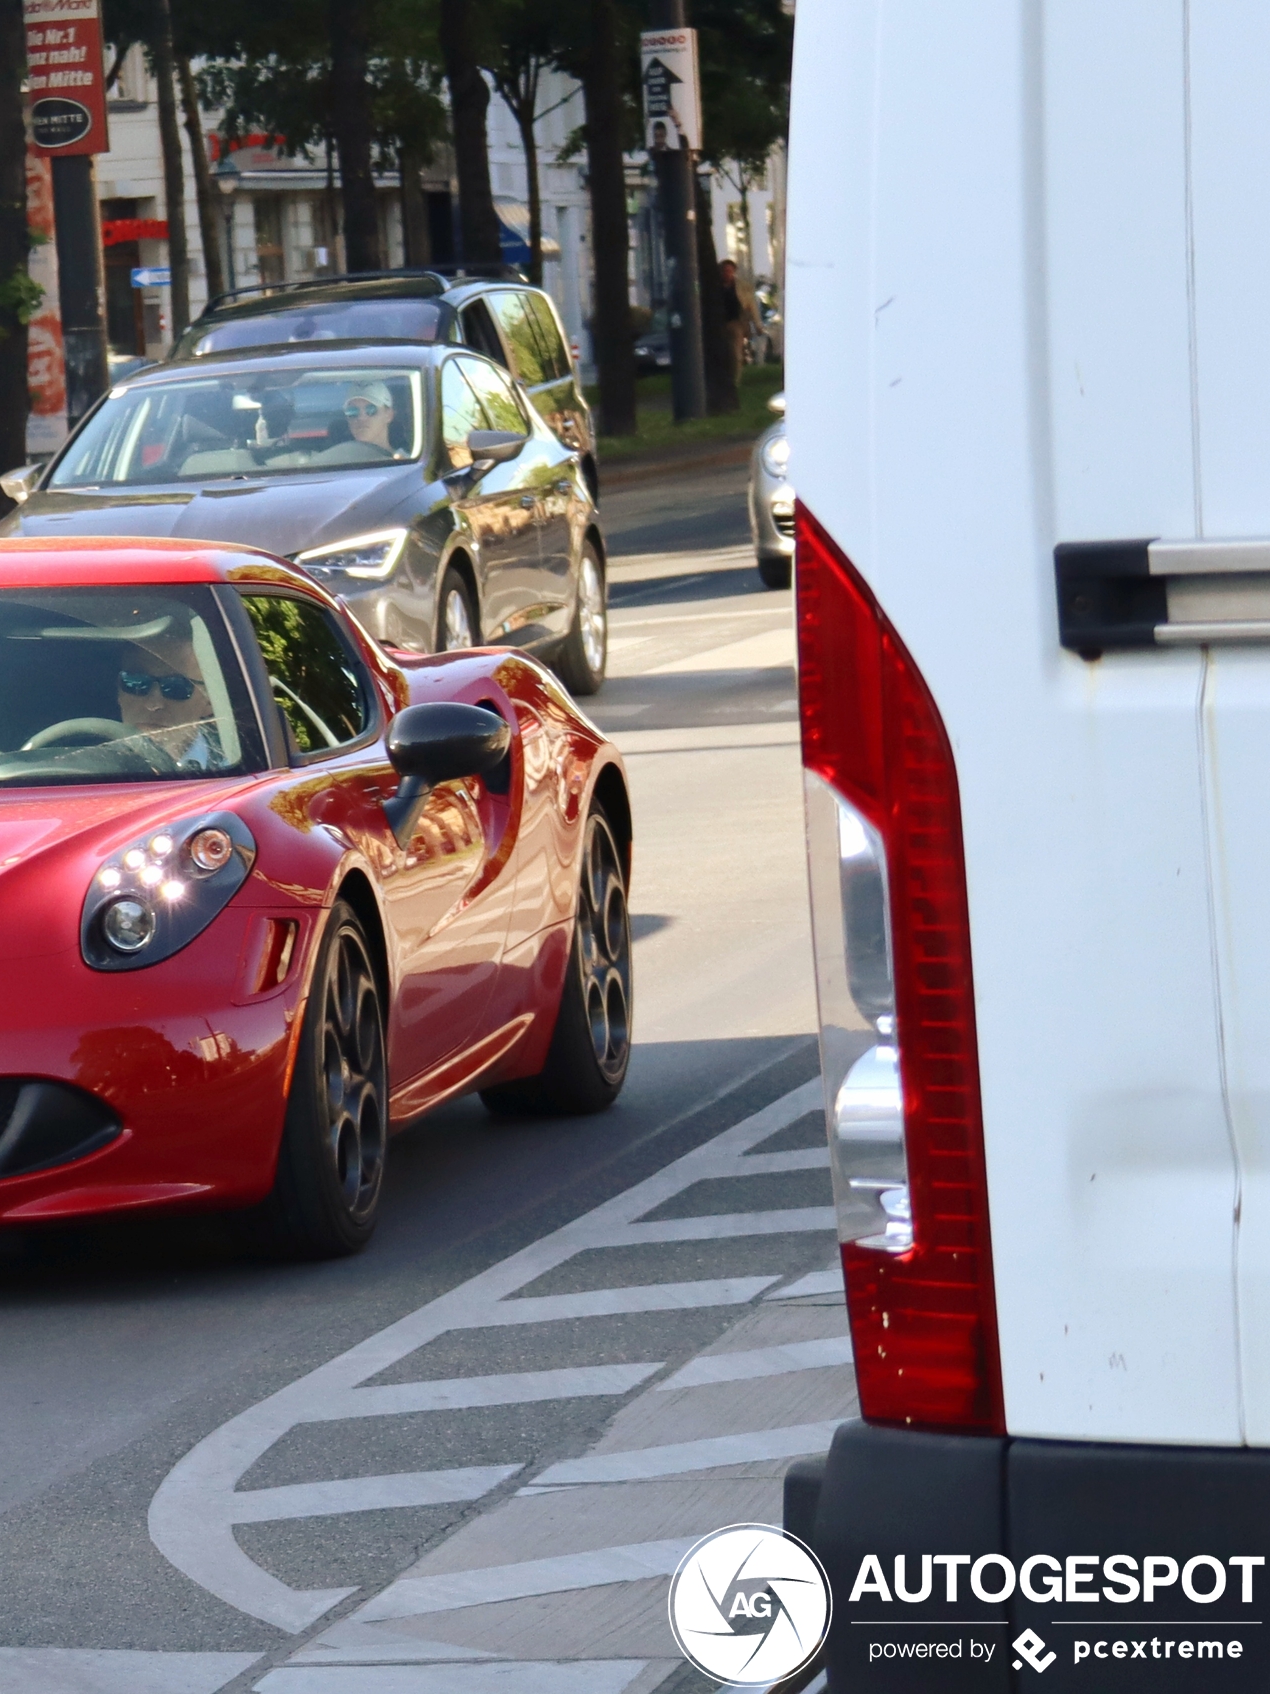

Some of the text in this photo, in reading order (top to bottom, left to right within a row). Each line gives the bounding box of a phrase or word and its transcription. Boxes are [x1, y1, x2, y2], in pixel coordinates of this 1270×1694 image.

[45, 27, 75, 44] Nr.1
[49, 46, 88, 64] nah!
[49, 71, 93, 87] Mitte
[50, 113, 83, 123] MITTE
